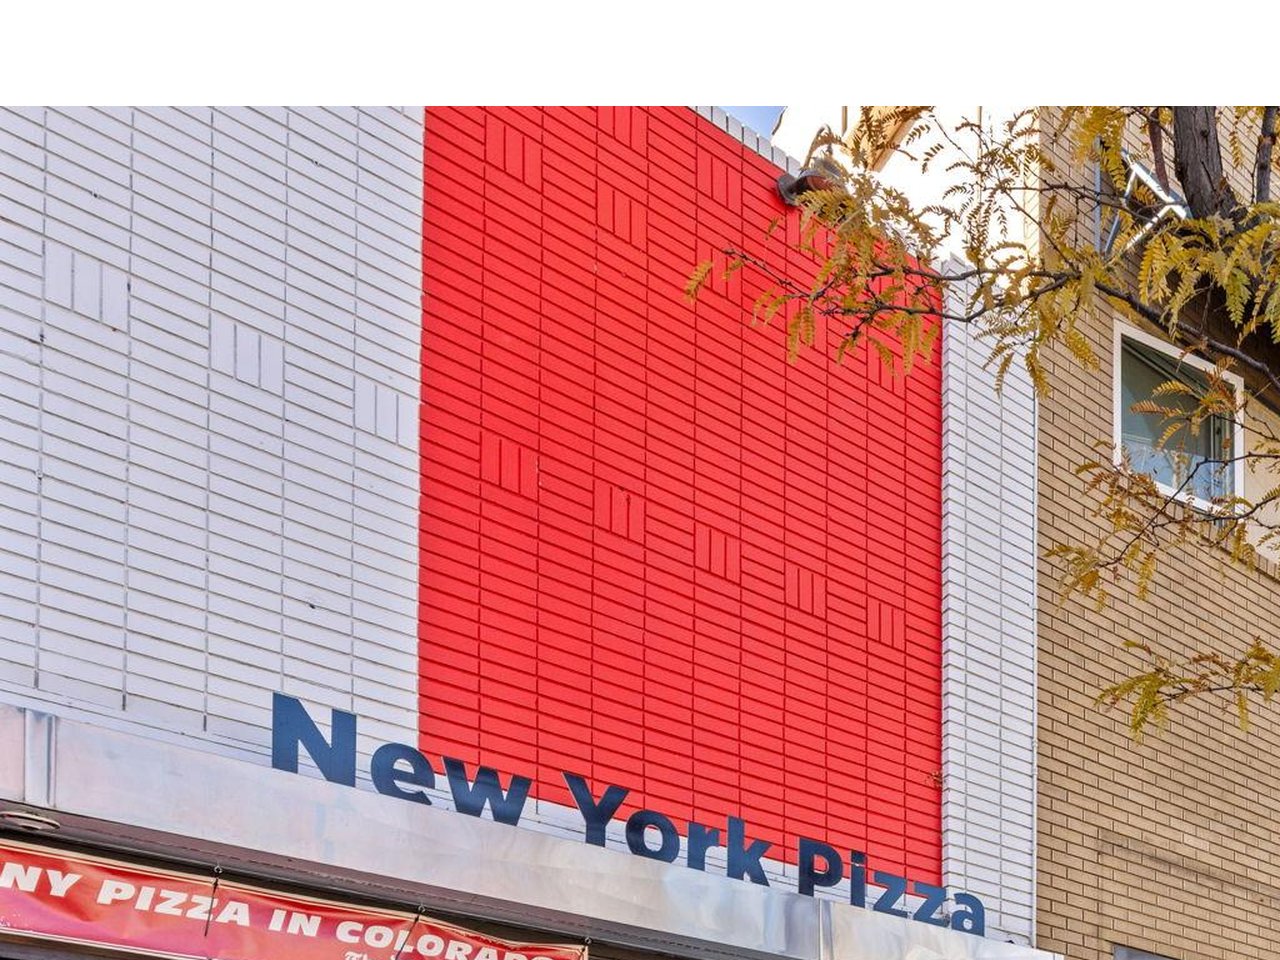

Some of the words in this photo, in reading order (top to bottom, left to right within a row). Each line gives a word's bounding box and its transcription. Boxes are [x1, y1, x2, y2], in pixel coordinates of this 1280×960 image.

[272, 692, 532, 827] New
[562, 771, 771, 888] York
[798, 836, 986, 938] Pizza
[0, 861, 82, 898] NY
[97, 879, 250, 927] PIZZA
[268, 909, 321, 937] IN
